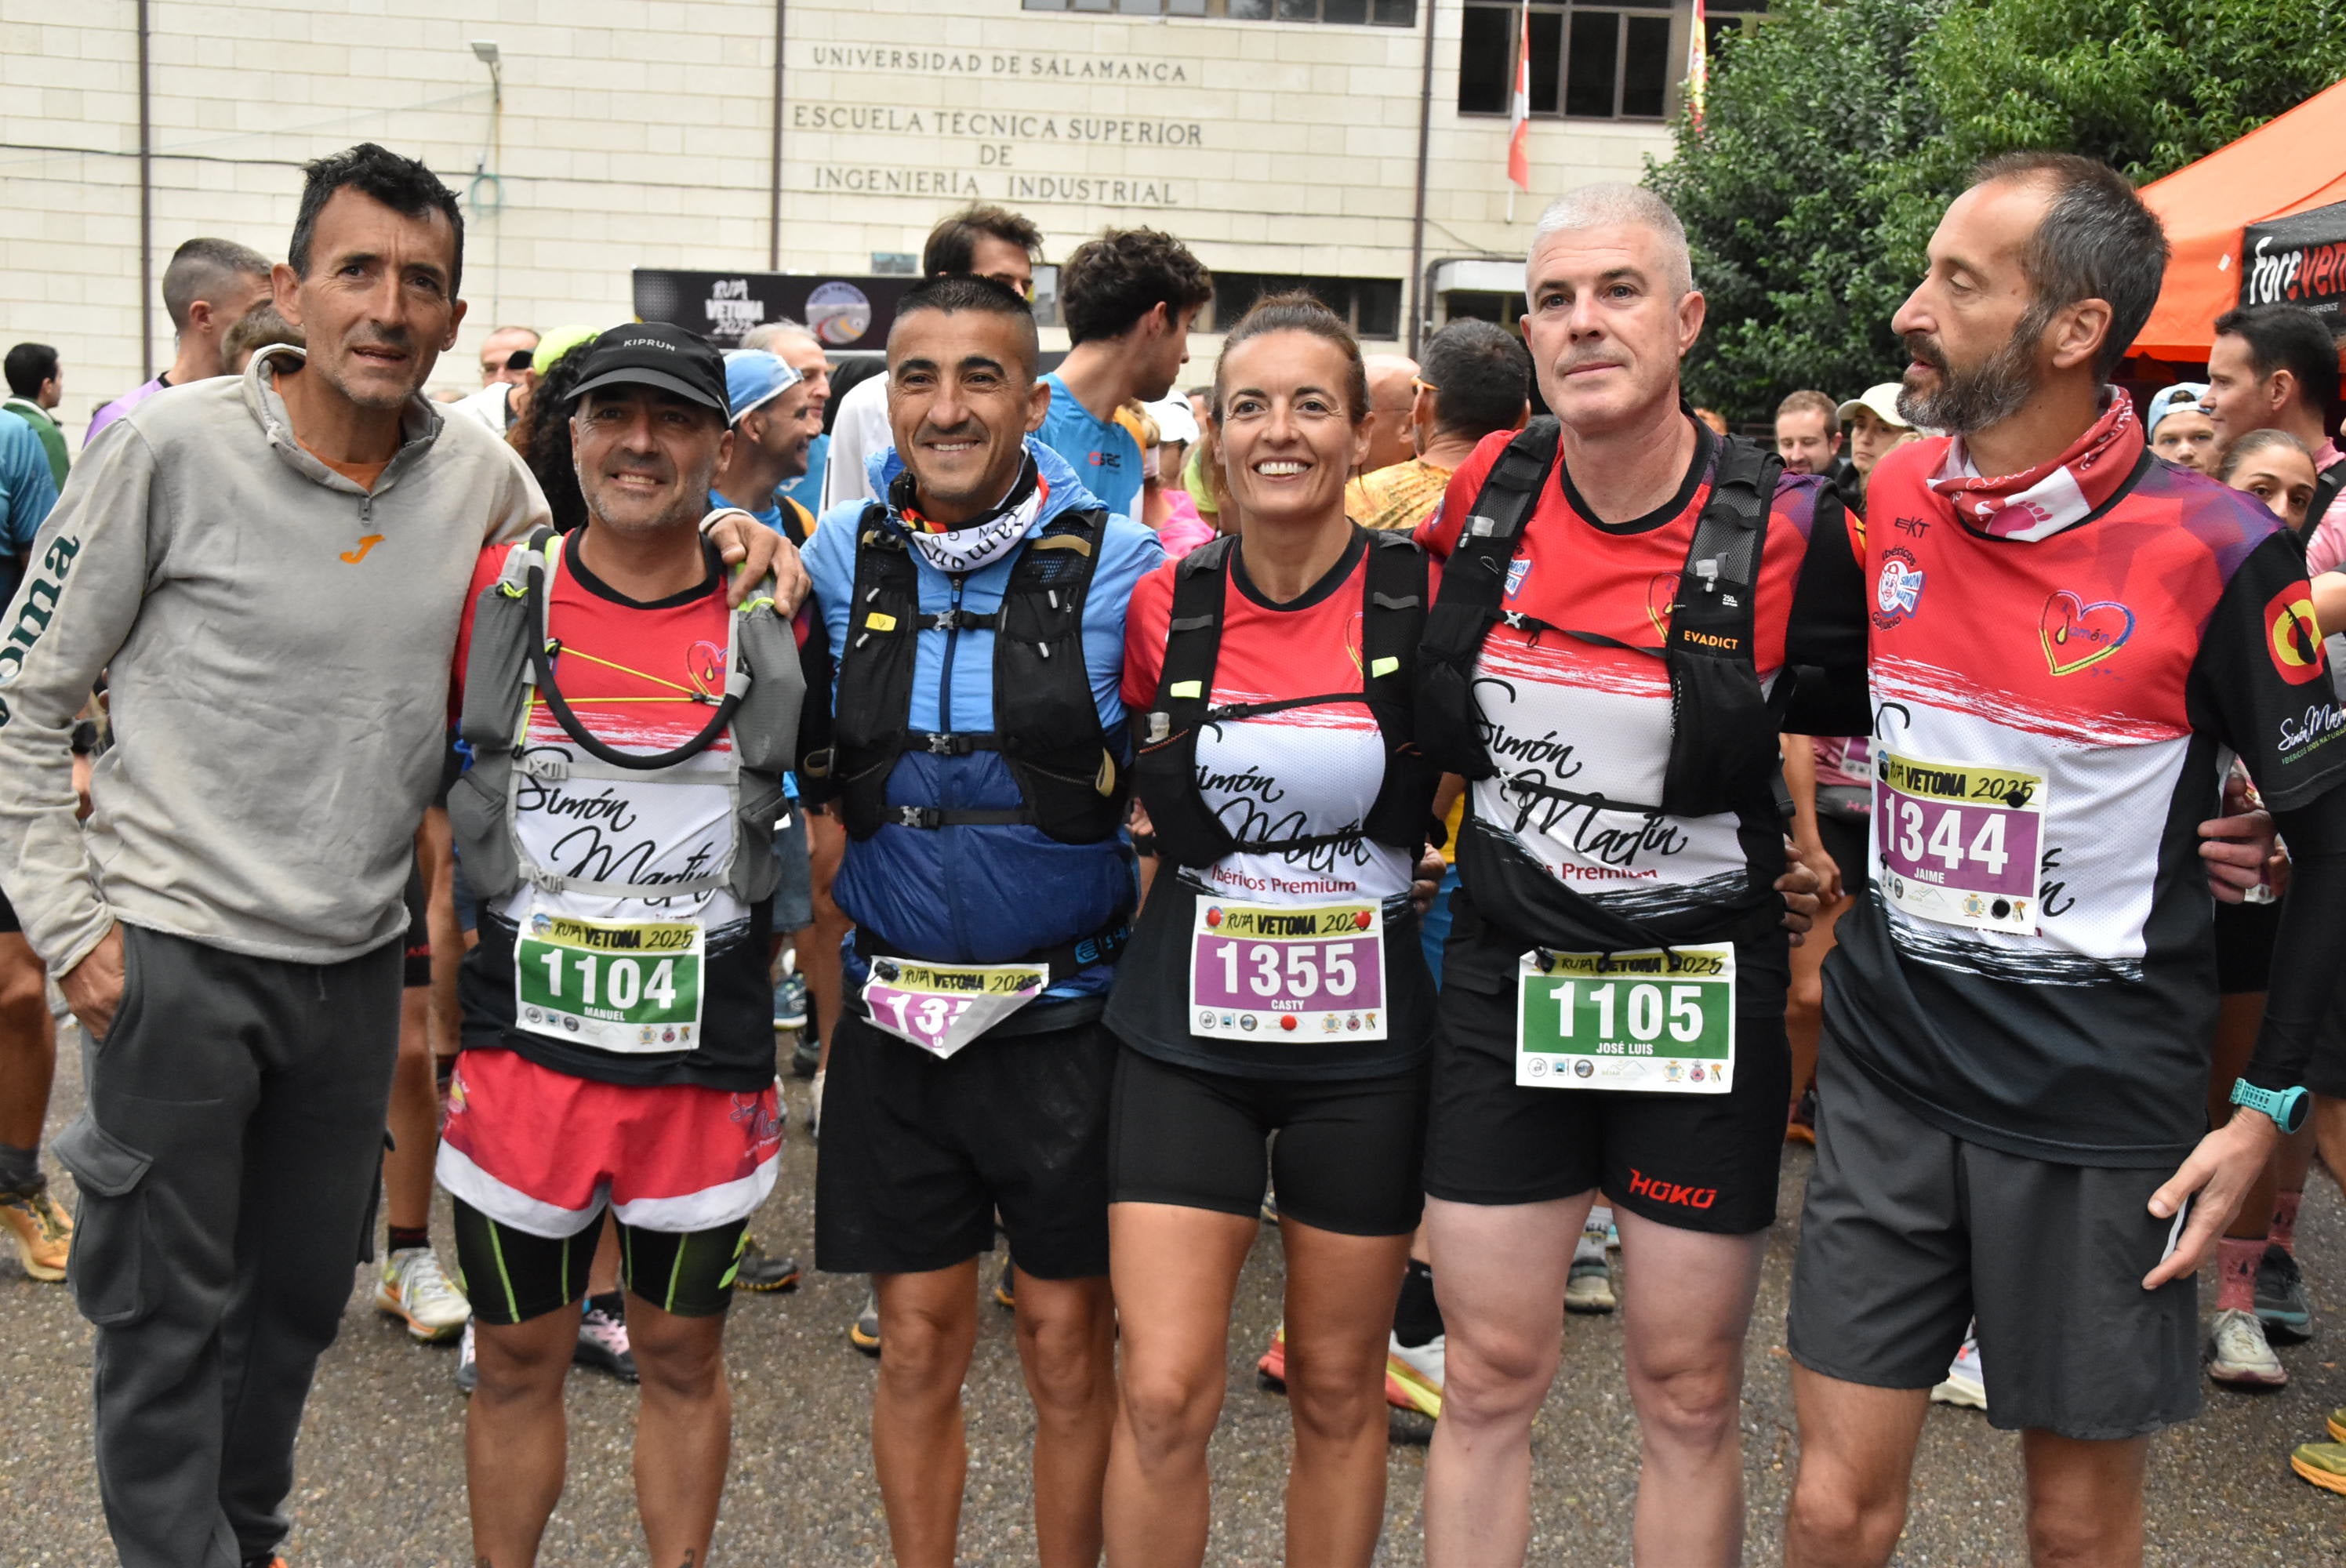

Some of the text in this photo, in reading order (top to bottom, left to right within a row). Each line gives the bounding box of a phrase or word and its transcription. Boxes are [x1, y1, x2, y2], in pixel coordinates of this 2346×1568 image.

[813, 46, 1186, 82] UNIVERSIDAD DE SALAMANCA
[794, 105, 923, 132] ESCUELA
[1067, 118, 1202, 146] SUPERIOR
[979, 144, 1013, 166] DE
[1008, 175, 1178, 205] INDUSTRIAL
[623, 338, 676, 352] KIPRUN
[1894, 516, 1930, 539] EKT
[1684, 630, 1738, 650] EVADICT
[1471, 677, 1582, 778] Simón
[518, 746, 637, 832] Simón
[1890, 760, 1904, 787] RUTA
[1906, 766, 1966, 797] VETONA
[1886, 792, 2009, 875] 1344
[1271, 877, 1356, 894] Premium
[1914, 866, 1945, 884] JAIME
[555, 921, 694, 949] RUTA VETONA 2025
[1226, 912, 1254, 934] RUTA
[1258, 914, 1317, 935] VETONA
[1217, 942, 1357, 998] 1355
[1561, 957, 1593, 972] RUTA
[540, 948, 676, 1010] 1104
[905, 967, 930, 988] RUTA
[932, 971, 985, 991] VETONA
[584, 1006, 625, 1022] MANUEL
[1271, 999, 1305, 1011] CASTY
[1549, 981, 1703, 1042] 1105
[1596, 1040, 1654, 1056] JOSÉ LUIS
